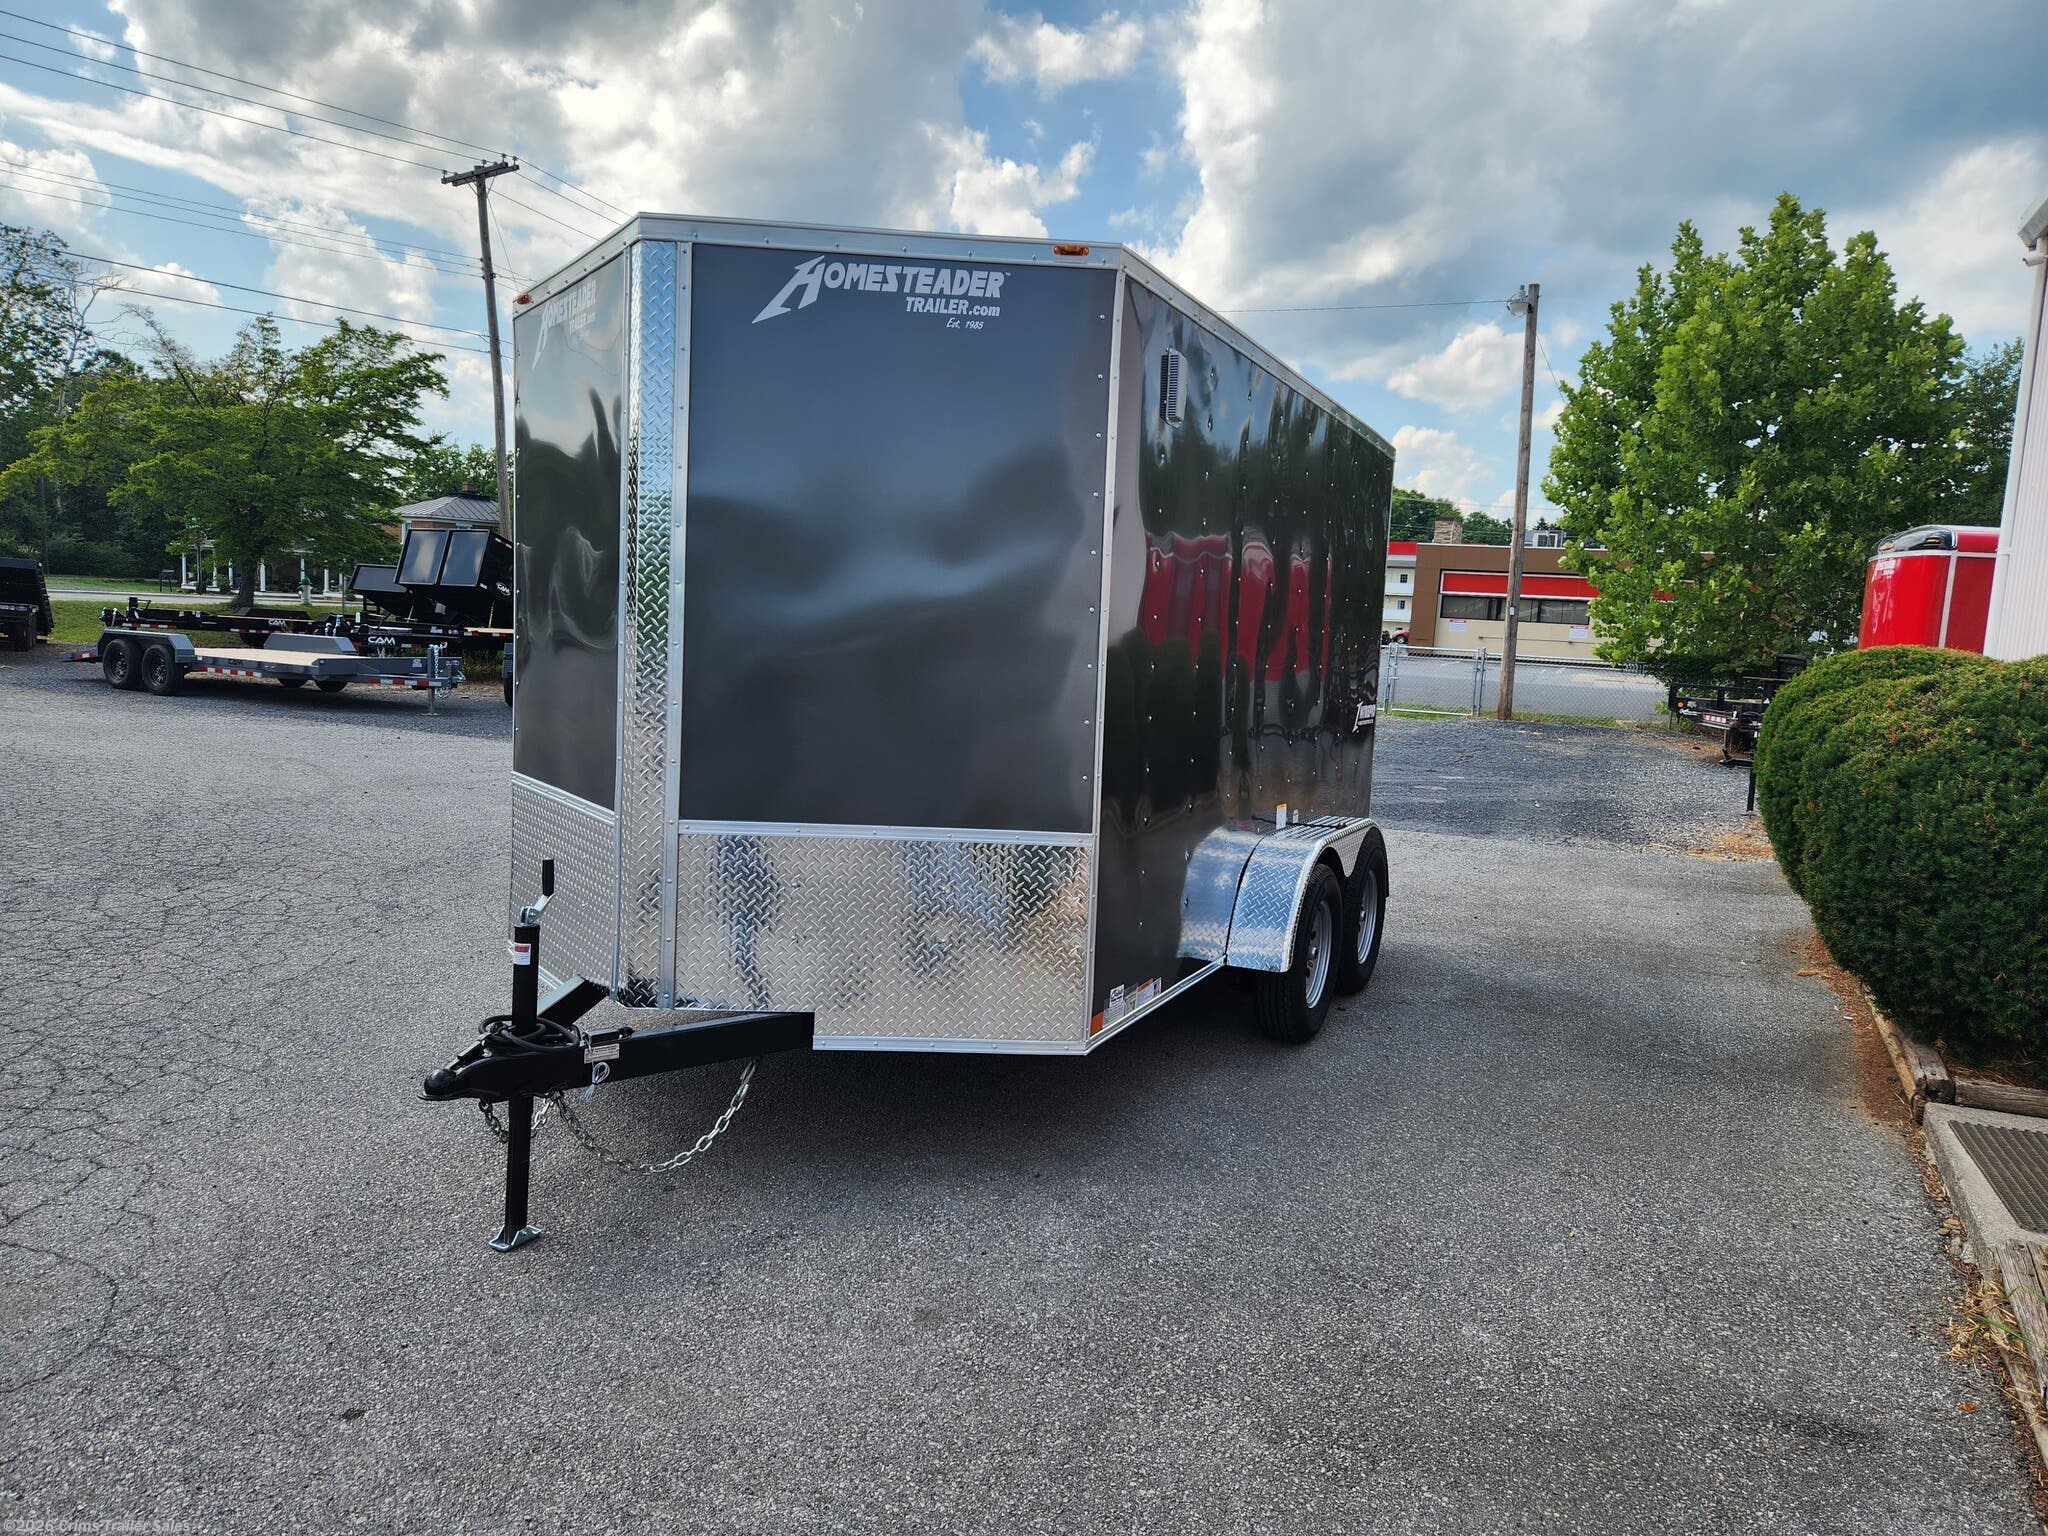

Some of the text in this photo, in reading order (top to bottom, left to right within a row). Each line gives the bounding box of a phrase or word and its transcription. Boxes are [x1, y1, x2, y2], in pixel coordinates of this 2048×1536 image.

[752, 255, 1005, 324] HOMESTEADER
[906, 297, 1001, 317] TRAILER.com
[965, 321, 984, 330] 1985
[367, 636, 396, 646] CAM
